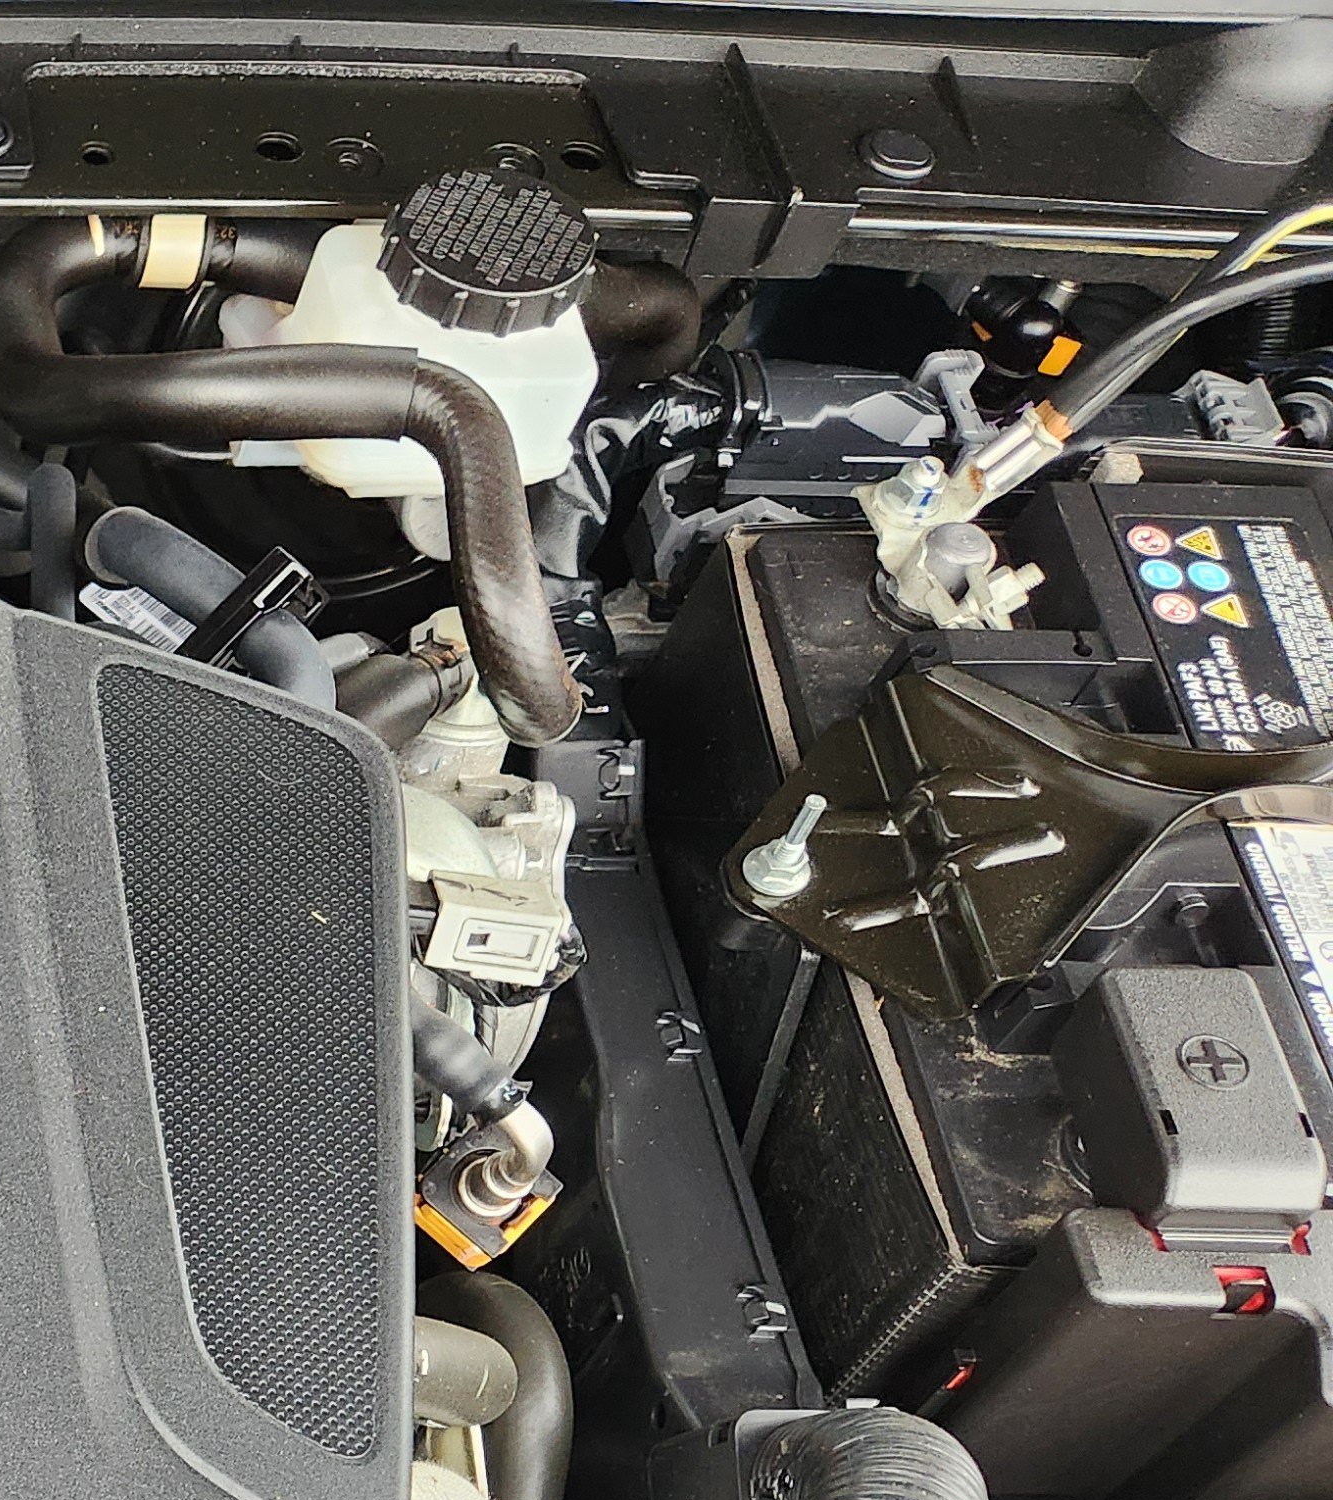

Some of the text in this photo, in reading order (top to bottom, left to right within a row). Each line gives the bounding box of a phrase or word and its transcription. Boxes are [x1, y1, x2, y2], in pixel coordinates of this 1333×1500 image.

[1195, 700, 1216, 732] LN2
[1244, 842, 1281, 897] VENENO
[1271, 904, 1312, 962] PELIGRO
